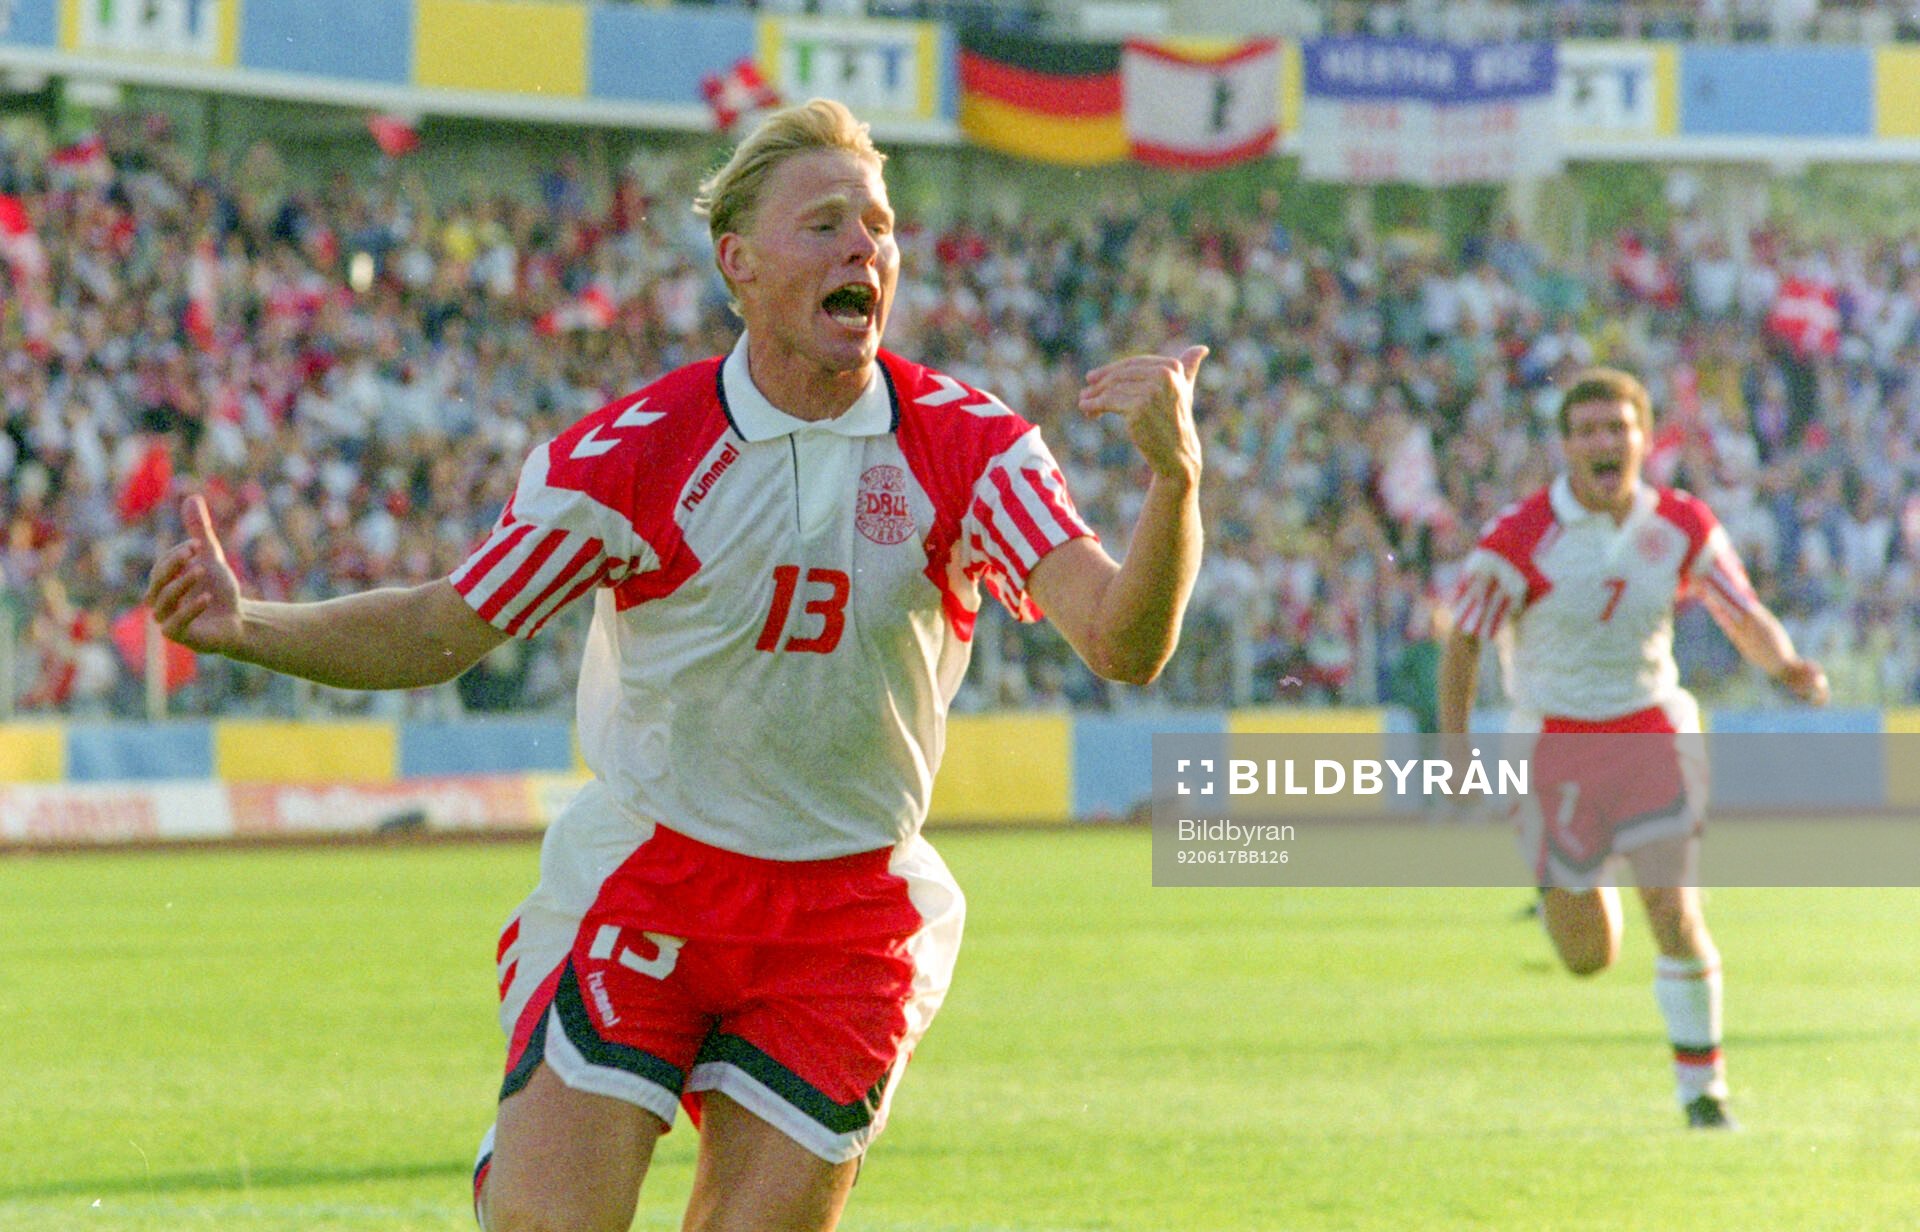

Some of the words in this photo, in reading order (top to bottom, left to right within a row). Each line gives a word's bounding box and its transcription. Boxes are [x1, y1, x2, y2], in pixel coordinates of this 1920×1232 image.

[682, 442, 740, 512] hummel
[866, 493, 907, 516] DBU
[755, 565, 850, 654] 13
[1600, 577, 1627, 622] 7
